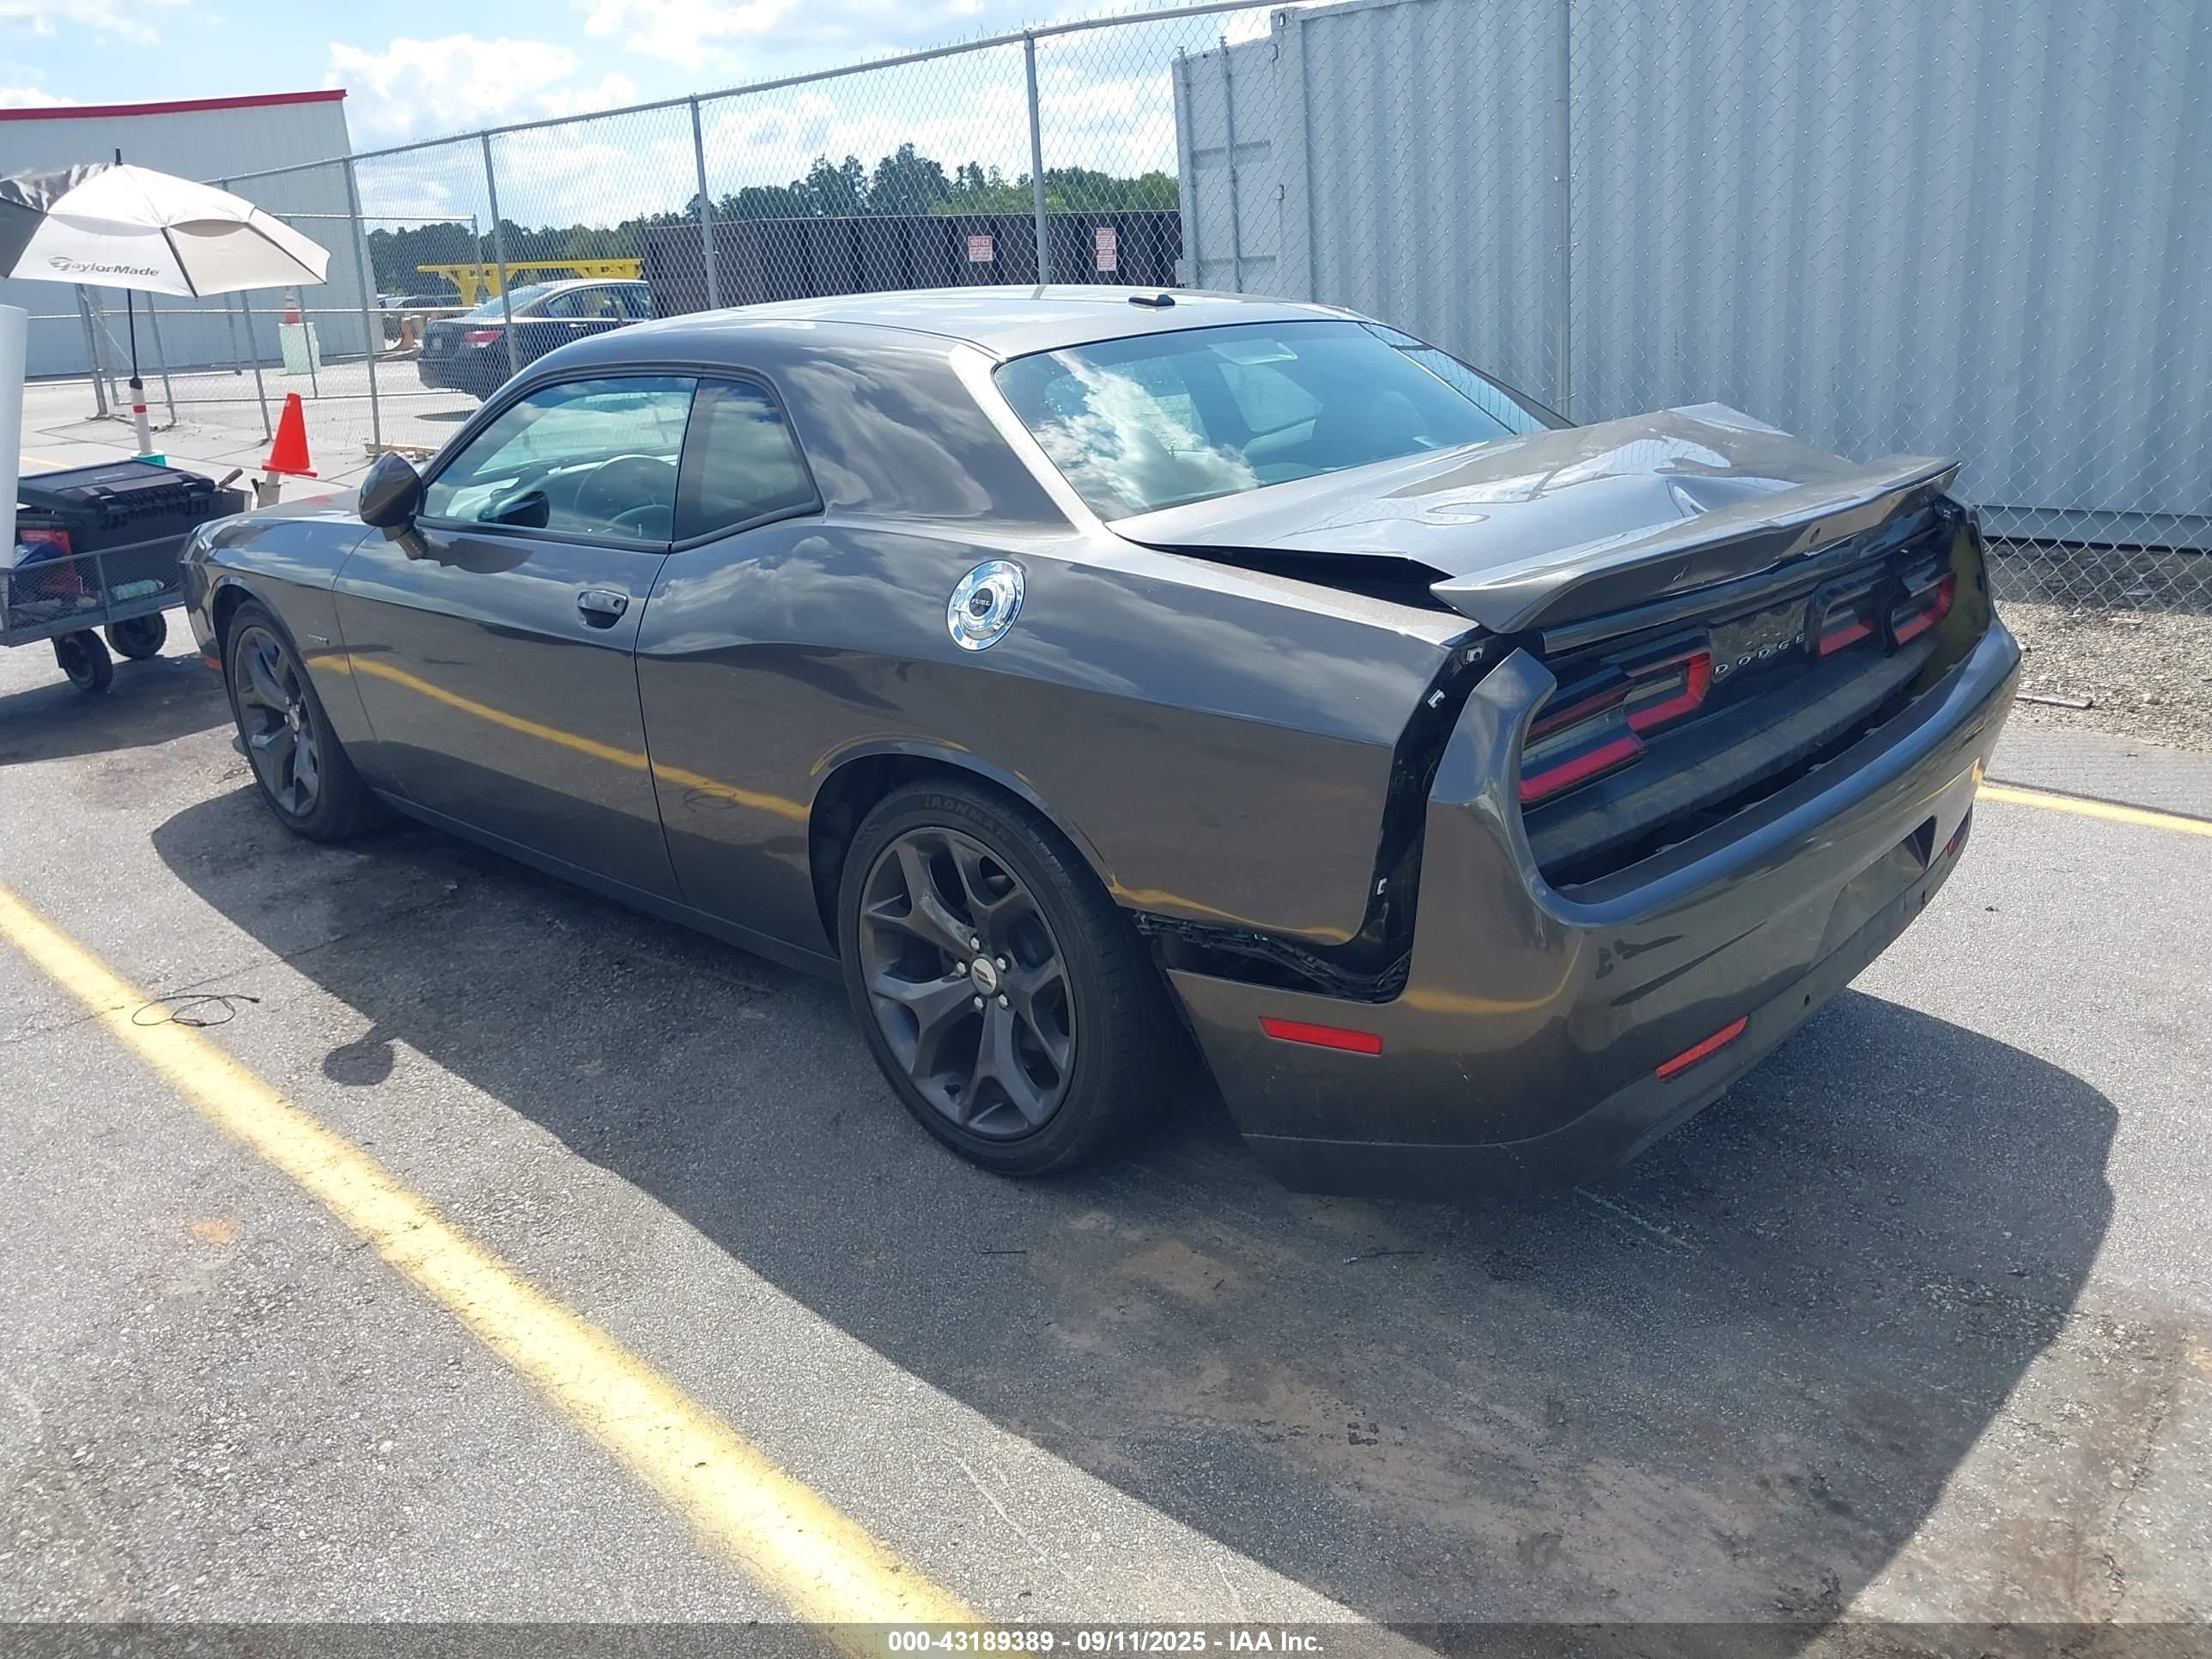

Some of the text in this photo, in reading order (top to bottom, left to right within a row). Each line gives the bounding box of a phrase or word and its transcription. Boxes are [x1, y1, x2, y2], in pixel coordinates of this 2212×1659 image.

[49, 257, 159, 276] TaylorMade
[971, 598, 991, 606] FUEL
[1714, 633, 1805, 676] DODGE
